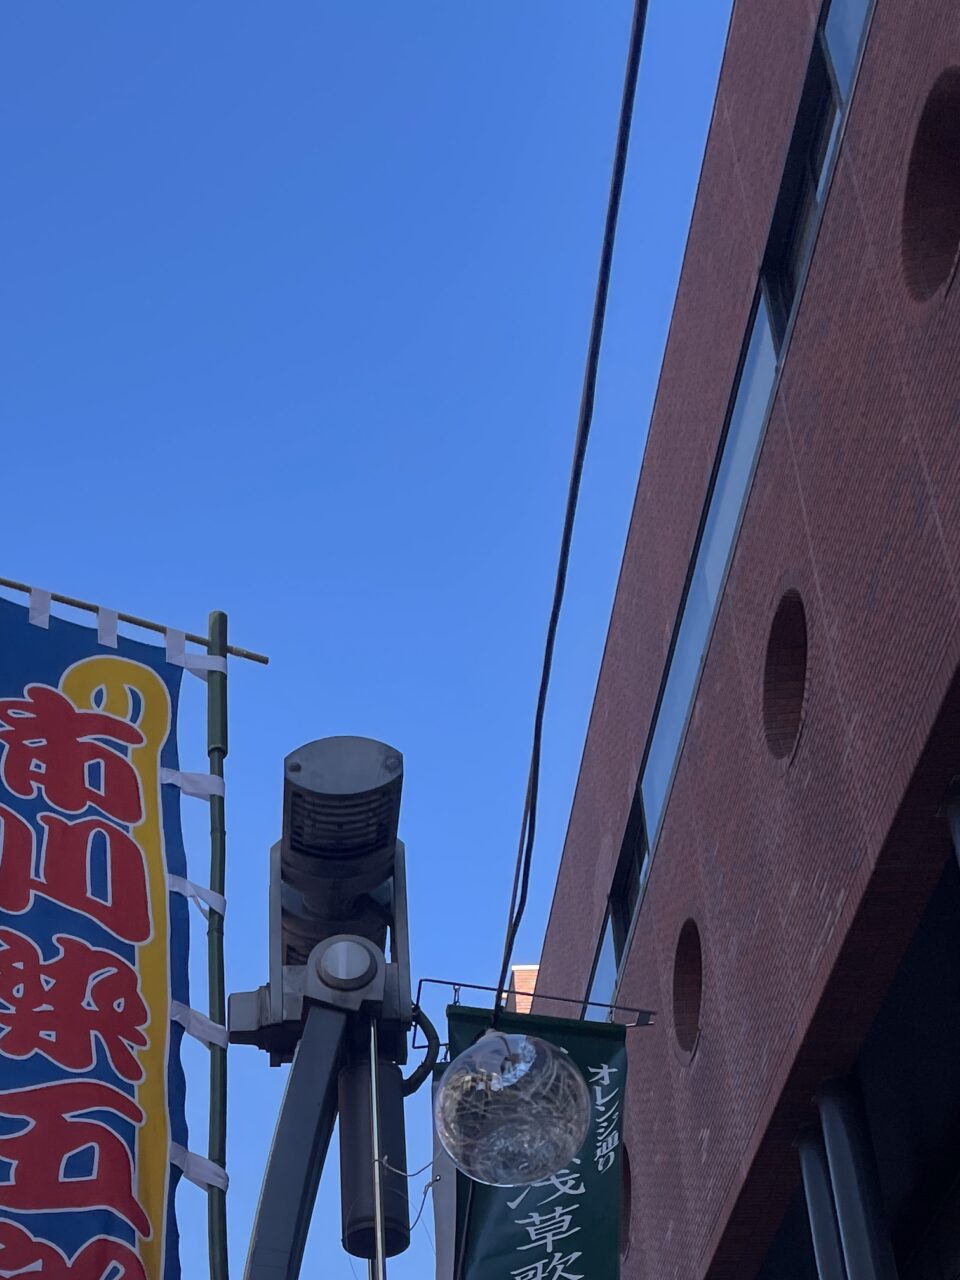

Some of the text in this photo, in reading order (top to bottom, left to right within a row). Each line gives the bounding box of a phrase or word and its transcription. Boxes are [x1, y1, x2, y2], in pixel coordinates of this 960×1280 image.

[586, 1062, 620, 1175] オレンジ通り
